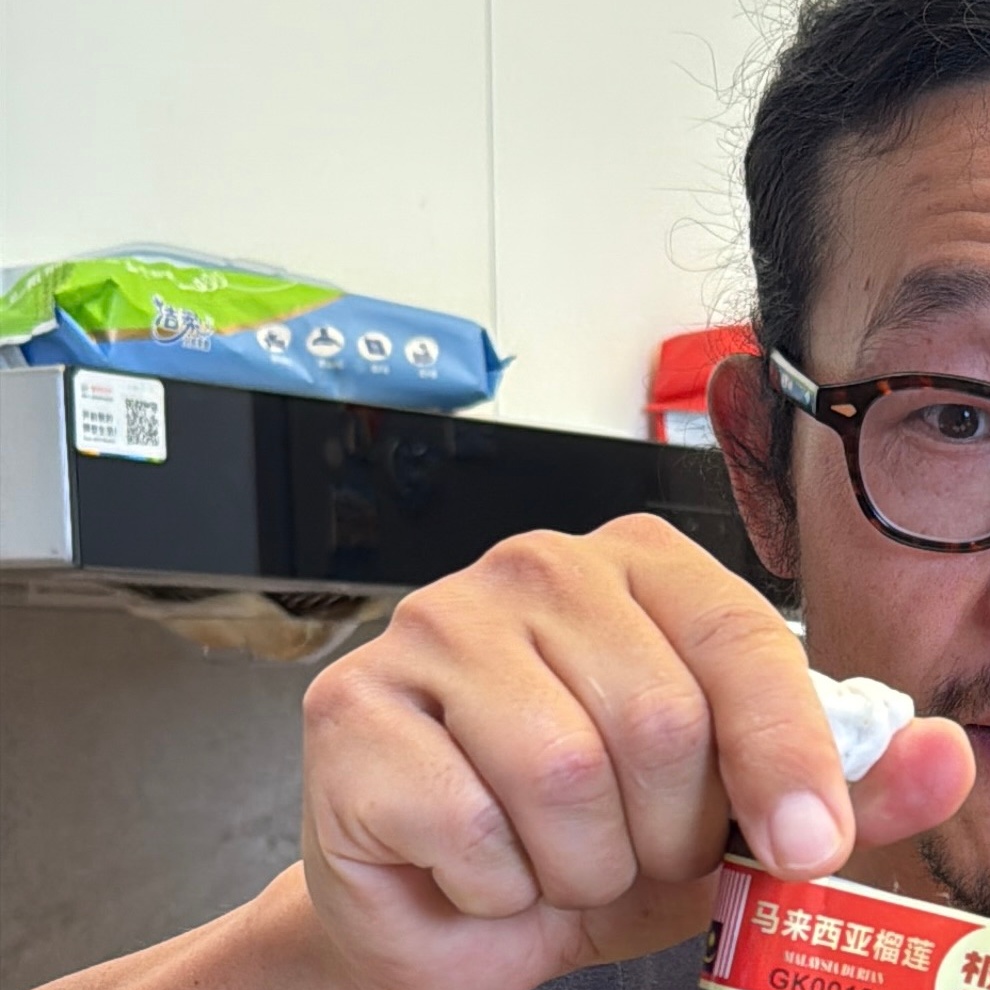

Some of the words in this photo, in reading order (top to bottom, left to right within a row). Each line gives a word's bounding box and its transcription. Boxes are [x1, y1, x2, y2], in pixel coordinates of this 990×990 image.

[751, 900, 936, 972] 马来西亚榴莲
[784, 950, 841, 974] MALAYSIA
[840, 963, 885, 985] DURIAN
